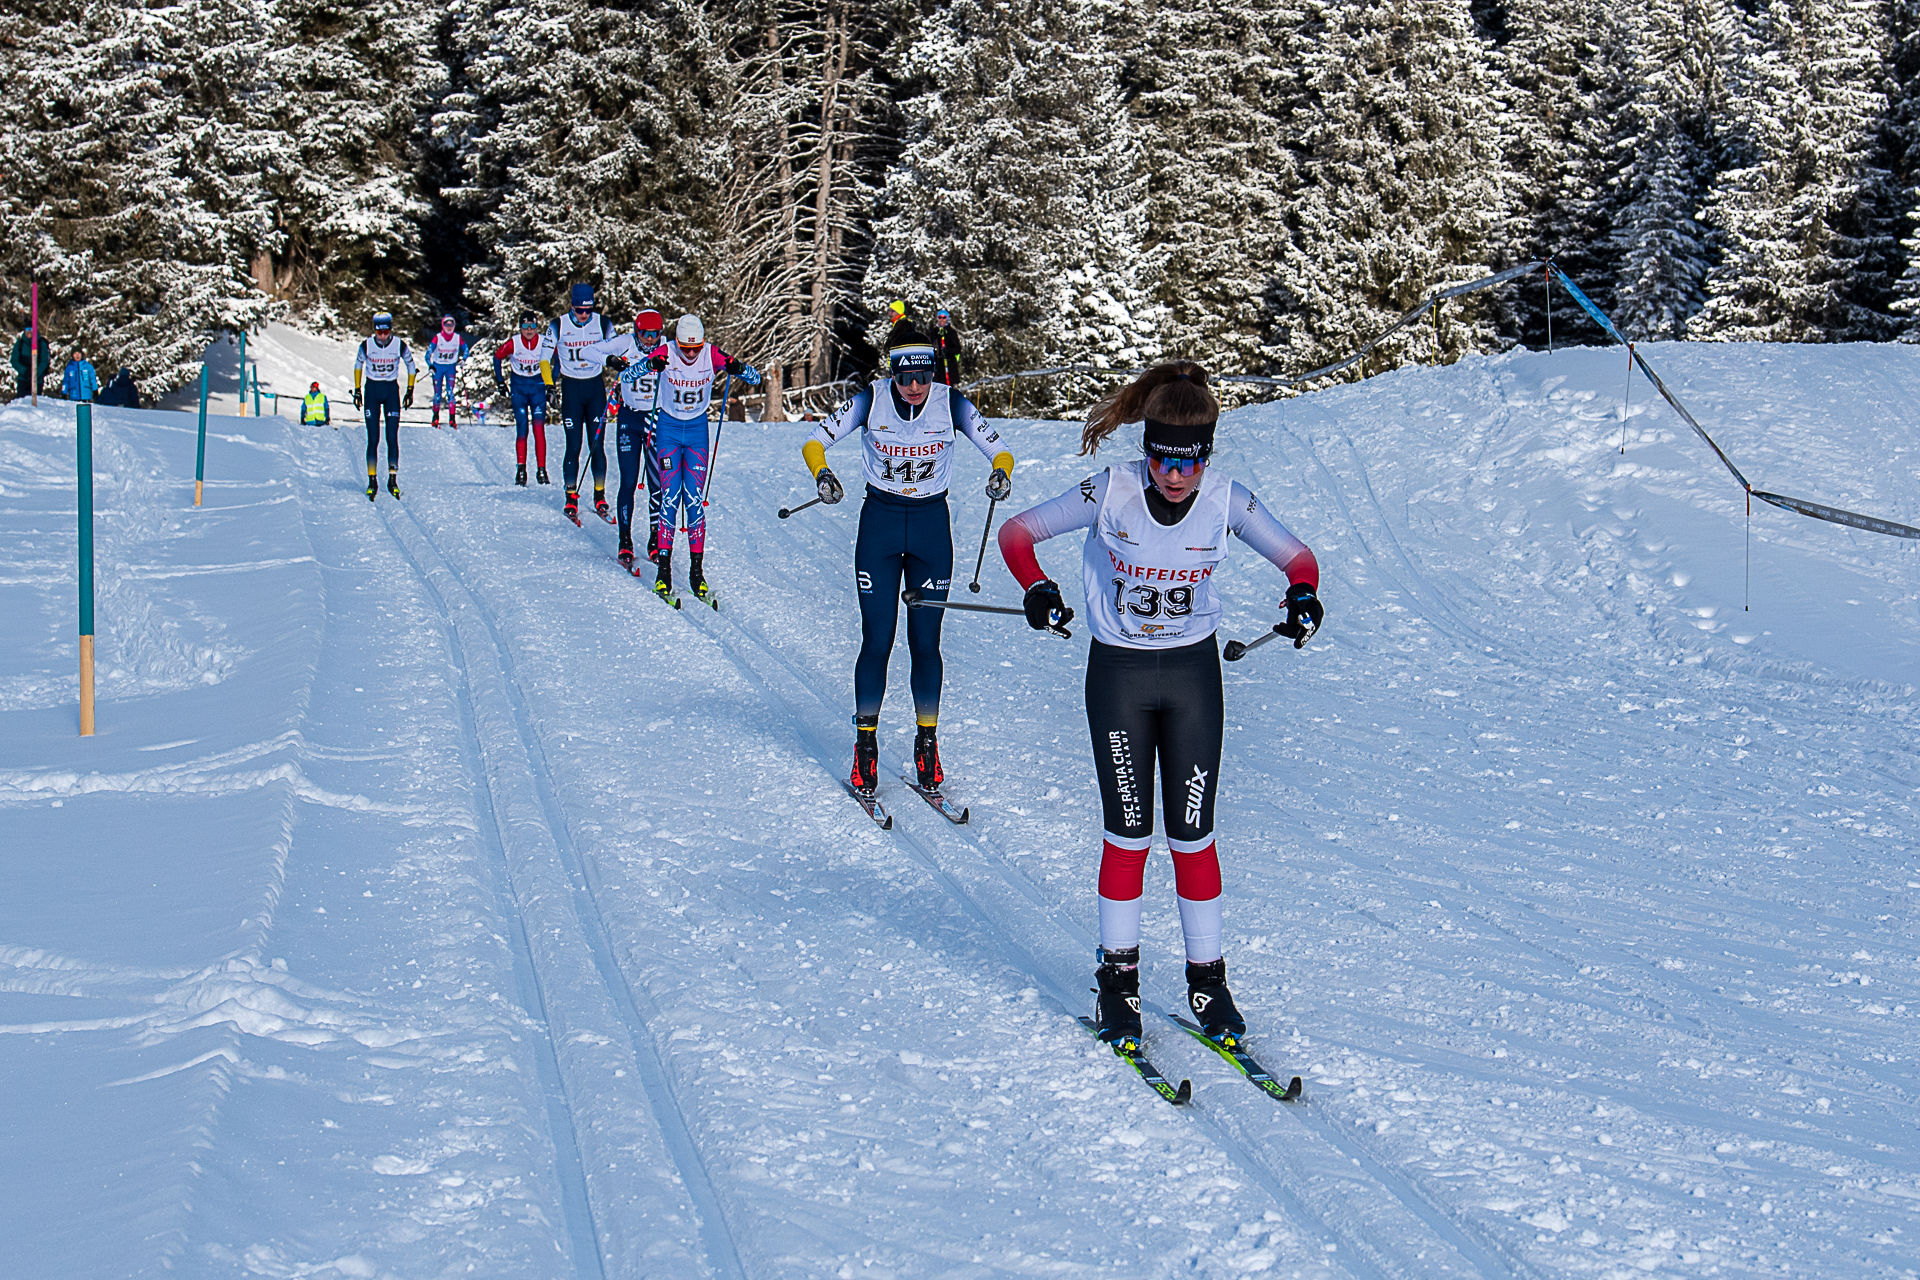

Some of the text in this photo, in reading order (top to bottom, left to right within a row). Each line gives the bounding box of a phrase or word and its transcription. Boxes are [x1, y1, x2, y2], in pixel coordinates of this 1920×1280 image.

[668, 376, 711, 388] RAIFFEISEN
[673, 387, 705, 404] 161
[875, 440, 944, 457] RAIFFEISEN
[881, 457, 937, 483] 142
[1108, 550, 1214, 583] RAIFFEISEN
[1112, 577, 1195, 619] 139
[1109, 730, 1136, 827] SSC RÄTIA CHUR
